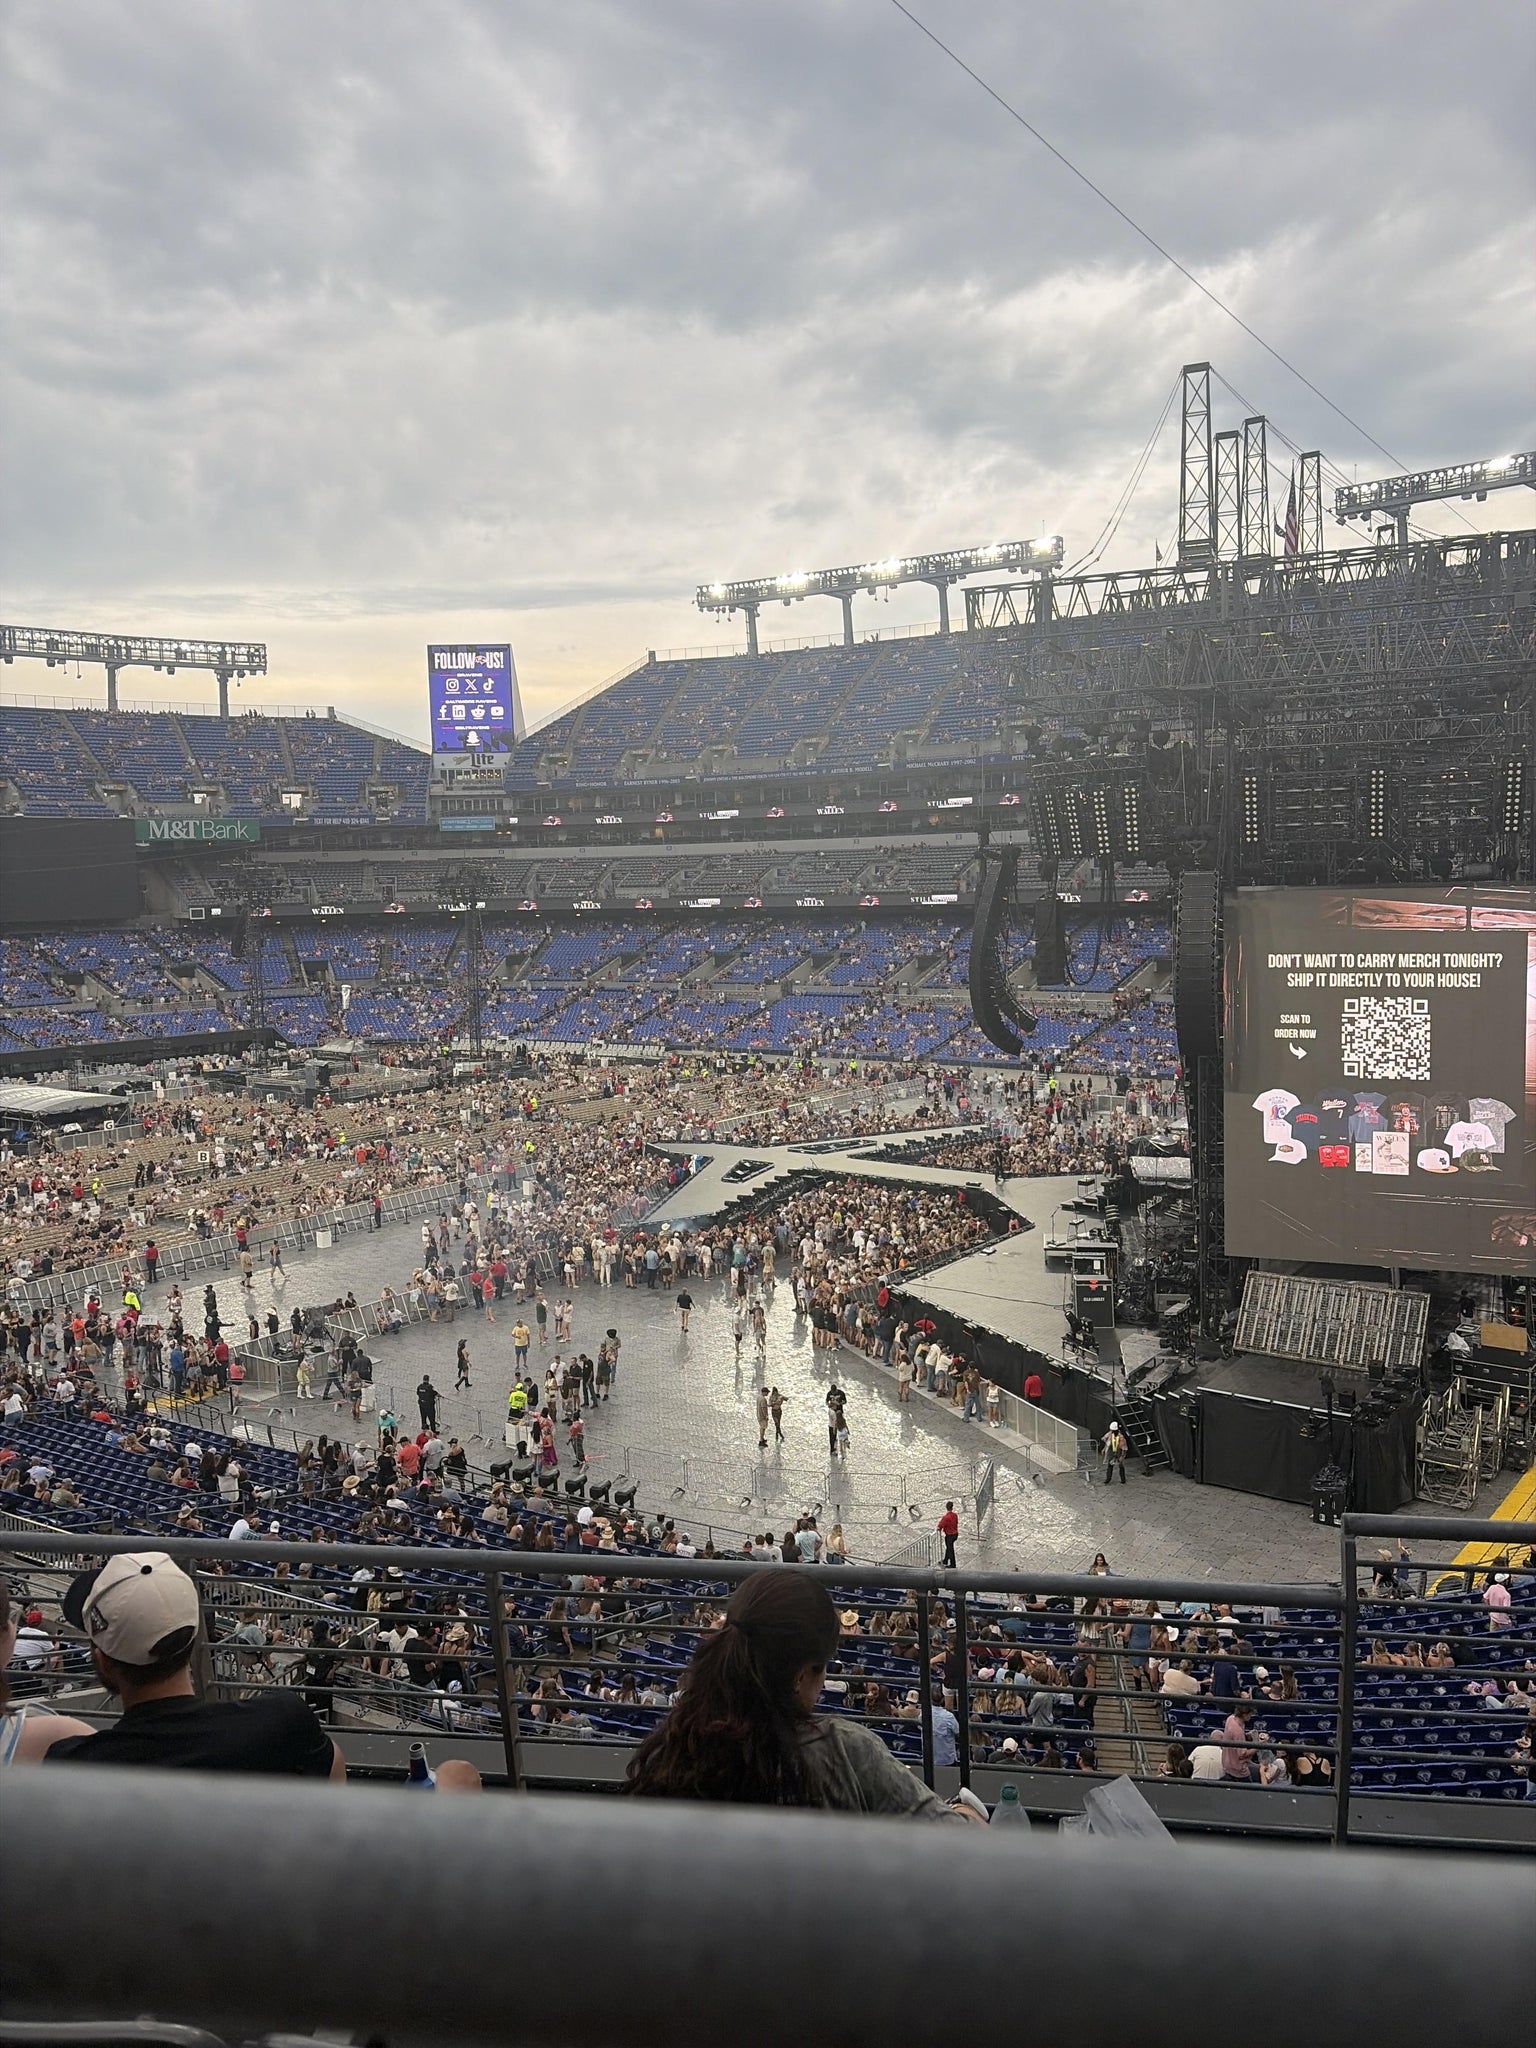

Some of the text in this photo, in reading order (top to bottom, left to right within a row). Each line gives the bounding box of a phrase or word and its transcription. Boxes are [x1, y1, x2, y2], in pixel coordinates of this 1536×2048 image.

[434, 652, 504, 669] FOLLOW US!
[471, 753, 494, 767] Lite
[817, 807, 844, 815] WALLEN
[314, 817, 323, 825] TEXT
[596, 816, 623, 824] WALLEN
[148, 820, 249, 839] M&T Bank
[573, 902, 601, 910] WALLEN
[796, 899, 825, 907] WALLEN
[311, 907, 344, 915] WALLEN
[1267, 953, 1503, 969] DON'T WANT TO CARRY MERCH TONIGHT?
[1287, 972, 1481, 988] SHIP IT DIRECTLY TO YOUR HOUSE!
[1280, 1014, 1311, 1024] SCAN TO
[1274, 1029, 1317, 1039] ORDER NOW
[1337, 1109, 1344, 1119] 7
[105, 1121, 113, 1129] G
[199, 1152, 208, 1161] B
